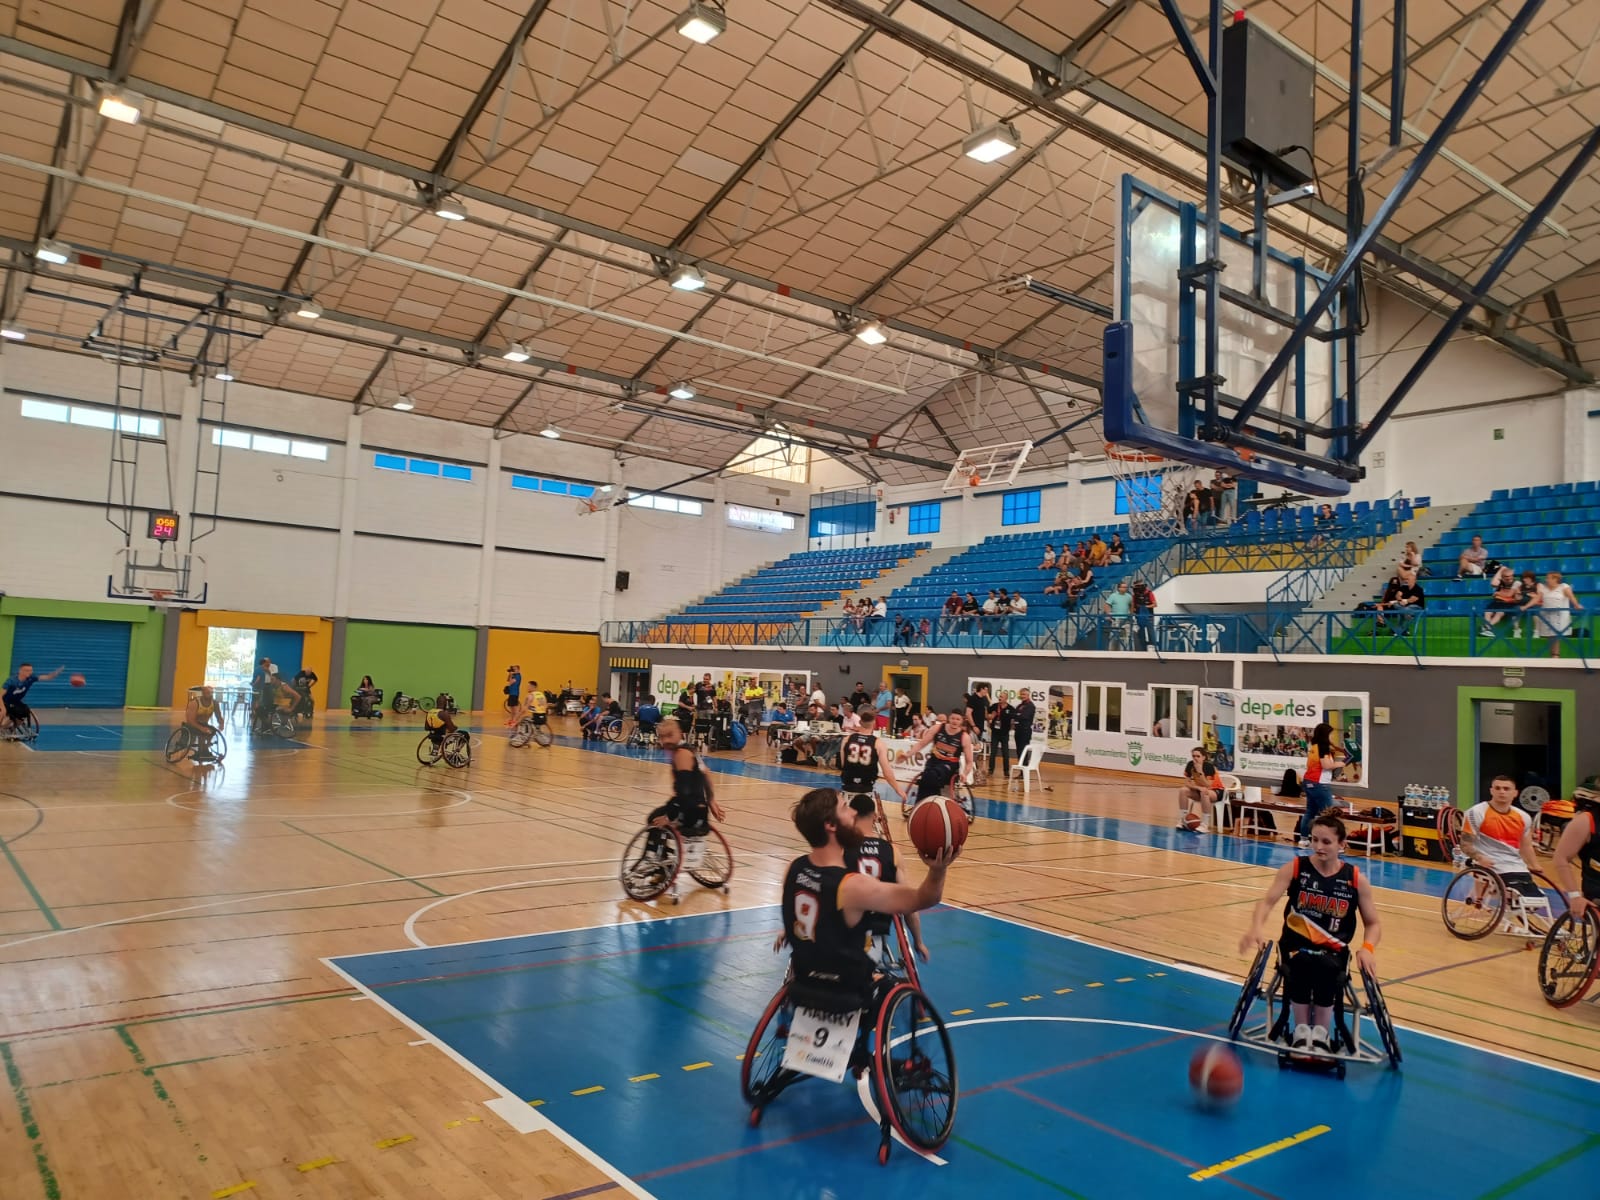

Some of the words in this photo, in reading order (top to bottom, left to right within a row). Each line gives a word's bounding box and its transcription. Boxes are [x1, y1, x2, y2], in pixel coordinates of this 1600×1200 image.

[153, 525, 172, 537] 24
[1240, 697, 1317, 720] deportes
[847, 743, 872, 766] 33
[1297, 890, 1349, 918] AMIAB
[793, 890, 820, 943] 9
[1329, 918, 1341, 931] 15
[813, 1027, 829, 1048] 9
